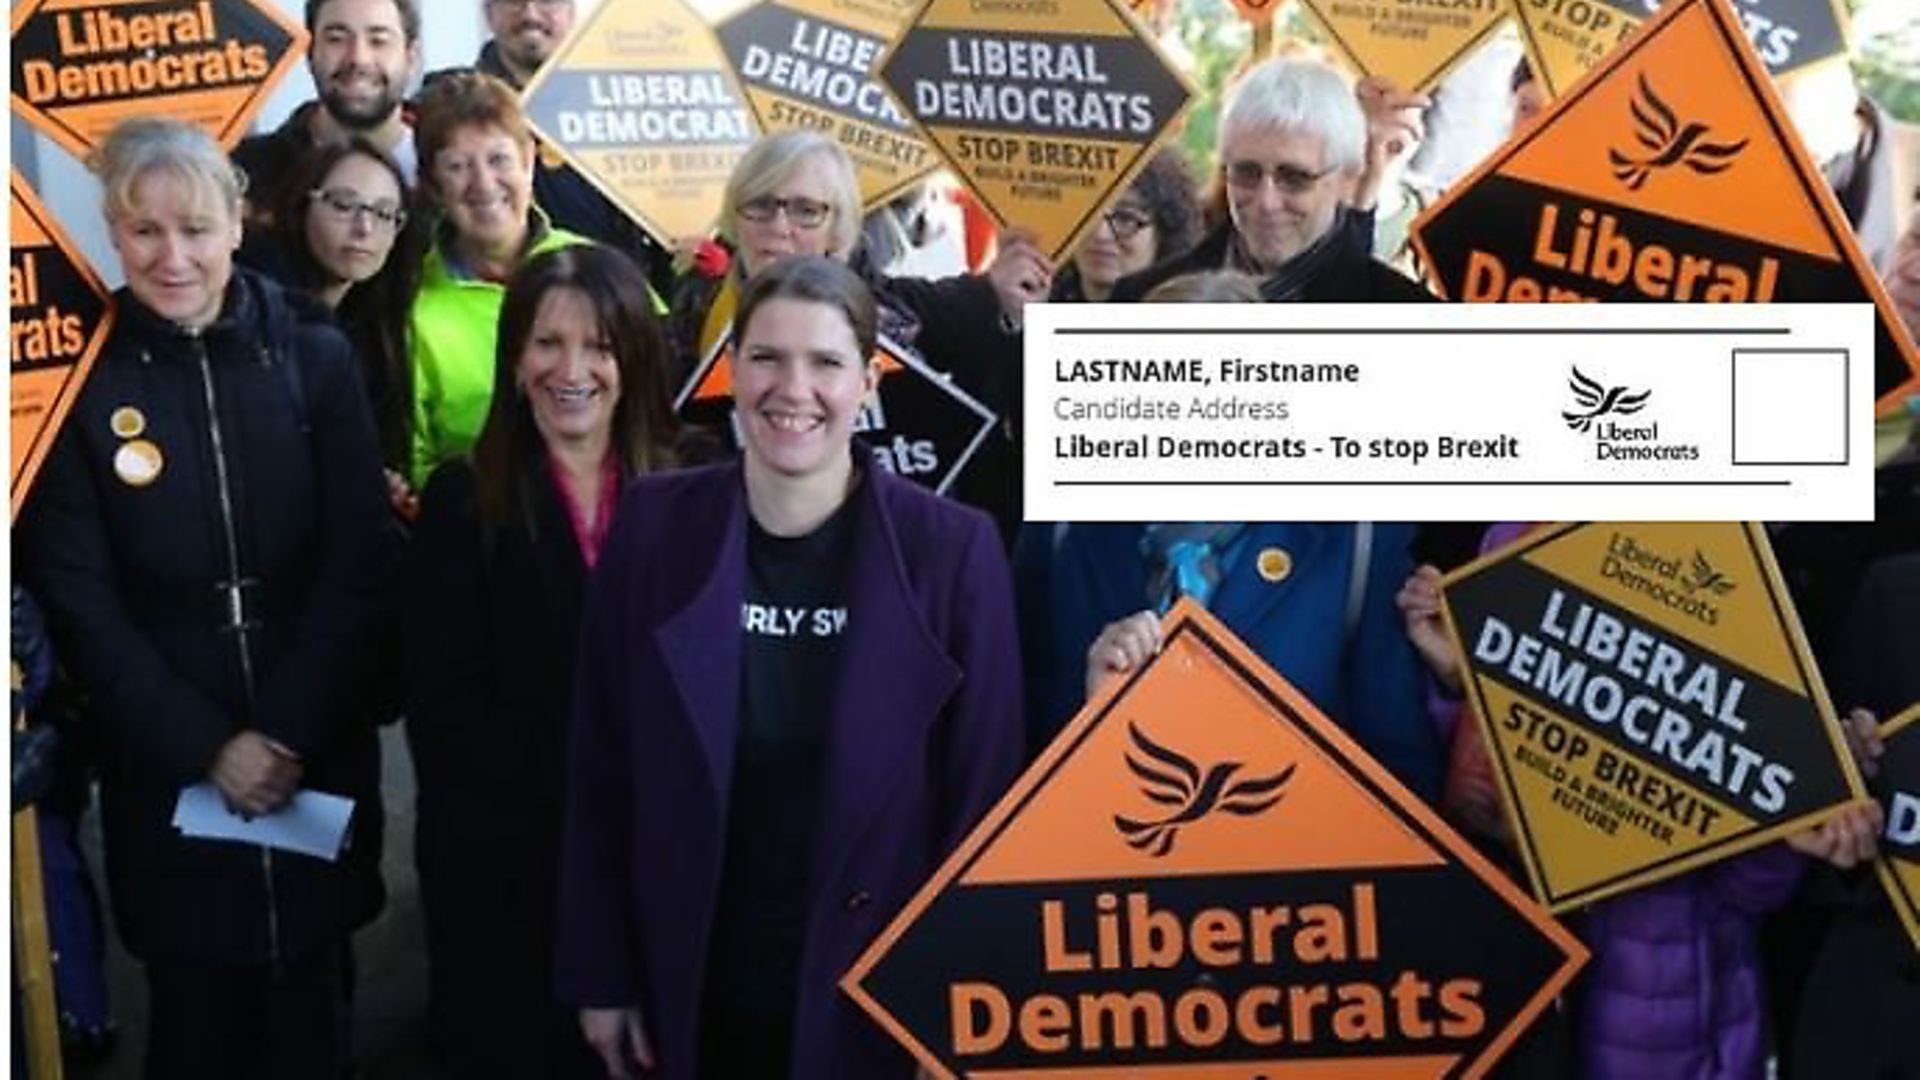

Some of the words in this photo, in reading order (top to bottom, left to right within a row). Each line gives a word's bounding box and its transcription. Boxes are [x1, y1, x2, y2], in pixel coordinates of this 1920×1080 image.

[57, 2, 216, 55] Liberal
[791, 20, 886, 72] LIBE
[23, 40, 268, 102] Democrats
[949, 38, 1106, 84] LIBERAL
[589, 73, 734, 106] LIBERAL
[915, 81, 1152, 131] DEMOCRATS
[839, 122, 928, 166] BREXIT
[957, 136, 1018, 163] STOP
[1027, 140, 1118, 170] BREXIT
[1533, 204, 1779, 302] Liberal
[1609, 532, 1681, 578] Liberal
[1600, 556, 1717, 626] Democrats
[1540, 589, 1747, 733] LIBERAL
[1475, 616, 1795, 815] DEMOCRATS
[1504, 702, 1589, 763] STOP
[1594, 750, 1721, 837] BREXIT
[1515, 745, 1566, 783] BUILD
[1552, 787, 1620, 836] FUTURE
[1042, 884, 1379, 972] Liberal
[948, 970, 1488, 1055] Democrats
